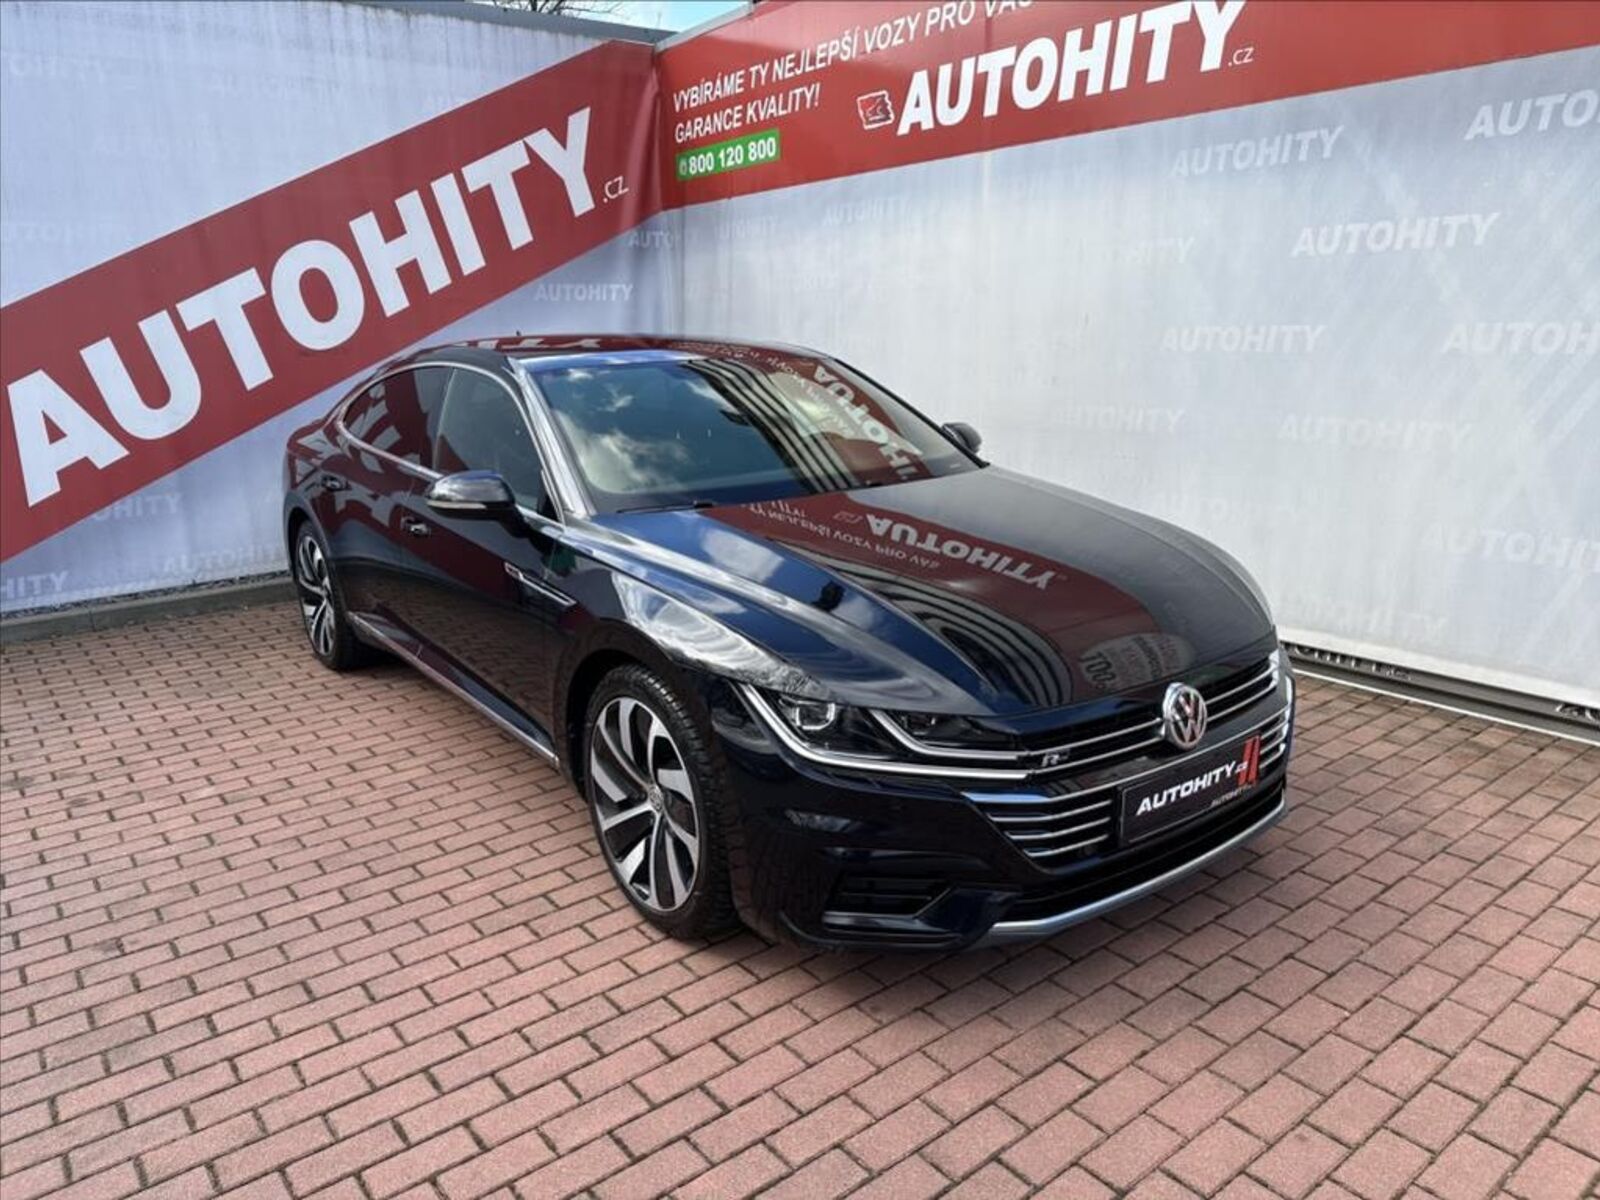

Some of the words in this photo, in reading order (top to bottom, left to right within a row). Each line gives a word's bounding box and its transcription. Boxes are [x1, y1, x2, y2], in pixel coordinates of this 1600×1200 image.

[673, 73, 745, 112] VYBÍRÁME
[749, 62, 770, 88] TY
[772, 26, 860, 82] NEJLEPŠÍ
[864, 12, 921, 50] VOZY
[925, 0, 976, 36] PRO
[675, 105, 743, 144] GARANCE
[746, 82, 821, 125] KVALITY!
[1463, 88, 1600, 140] AUTO
[689, 153, 714, 175] 800
[718, 145, 744, 168] 120
[748, 137, 776, 161] 800
[1170, 124, 1345, 178] AUTOHITY
[1290, 211, 1501, 258] AUTOHITY
[534, 282, 634, 302] AUTOHITY
[1160, 324, 1329, 353] AUTOHITY
